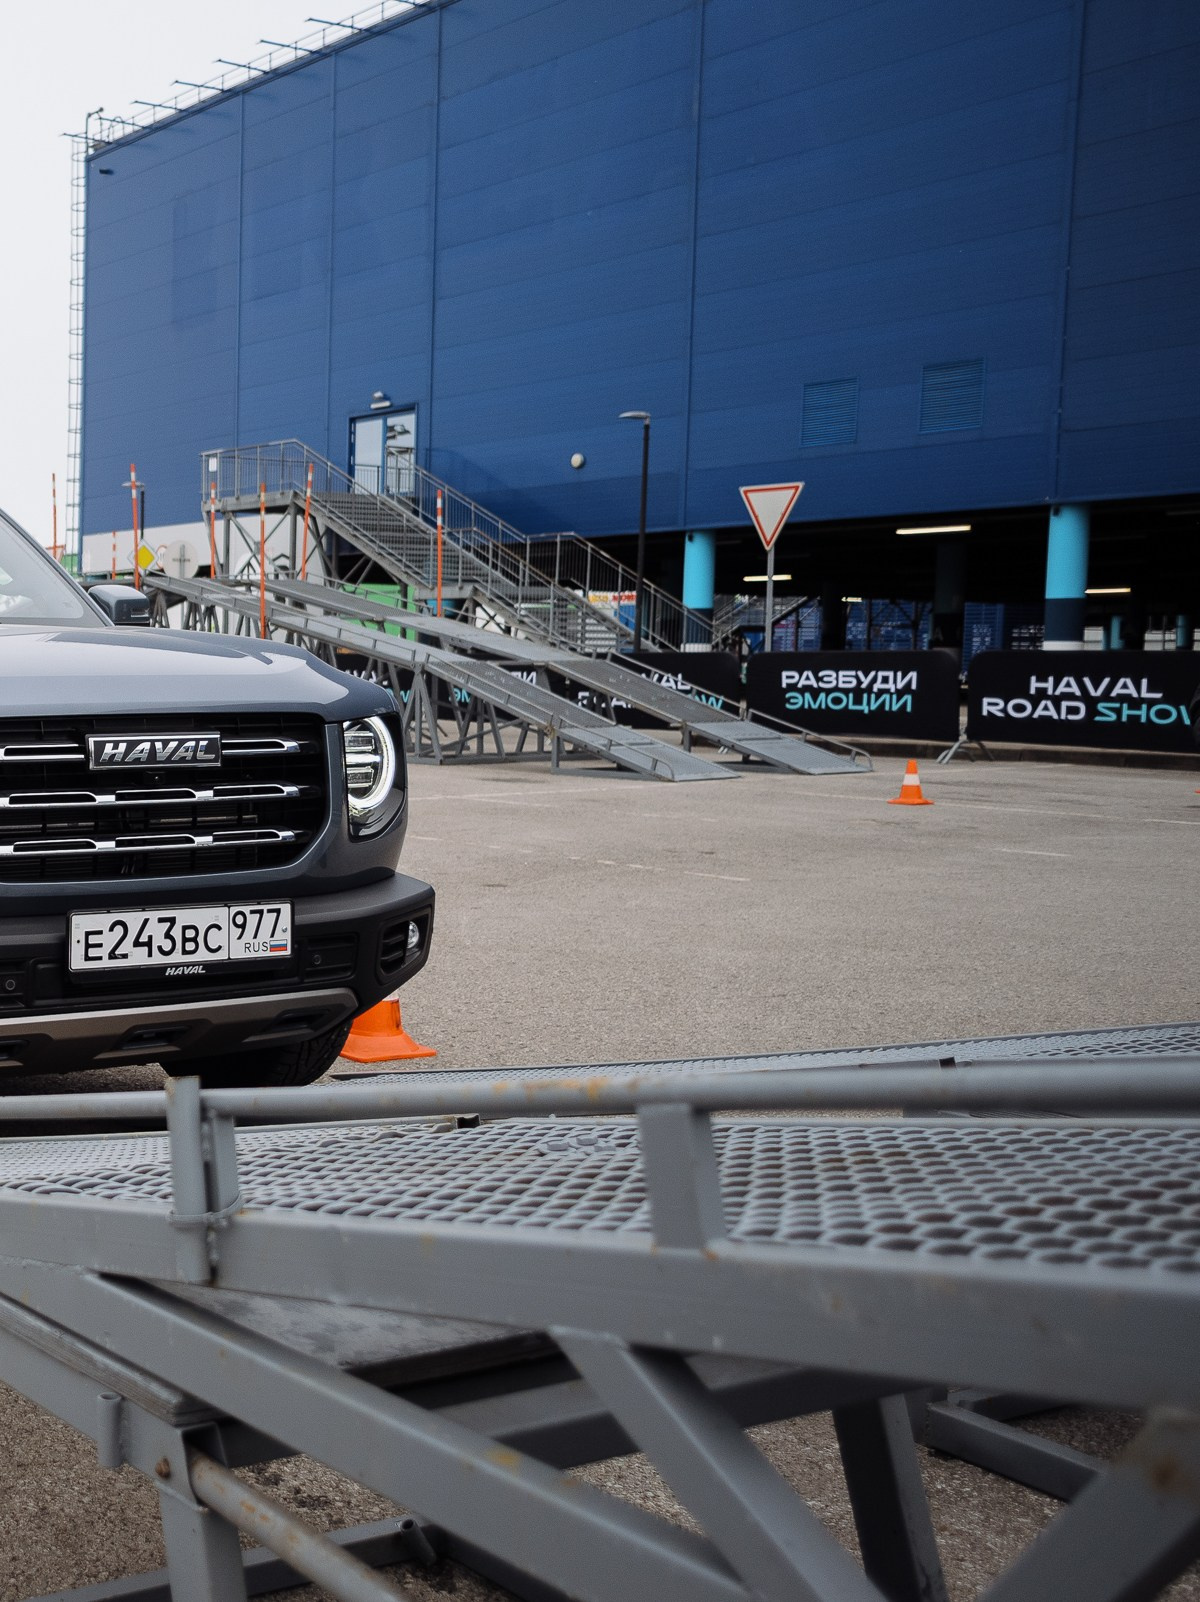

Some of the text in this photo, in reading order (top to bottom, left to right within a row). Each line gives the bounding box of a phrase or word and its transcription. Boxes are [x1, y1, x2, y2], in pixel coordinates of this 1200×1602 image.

[781, 670, 918, 693] РАЗБУДИ
[1029, 675, 1164, 699] HAVAL
[784, 691, 913, 714] ЭМОЦИИ
[981, 697, 1086, 720] ROAD
[99, 740, 216, 762] HAVAL
[231, 907, 282, 941] 977
[243, 941, 269, 954] RUS
[164, 965, 206, 977] HAVAL
